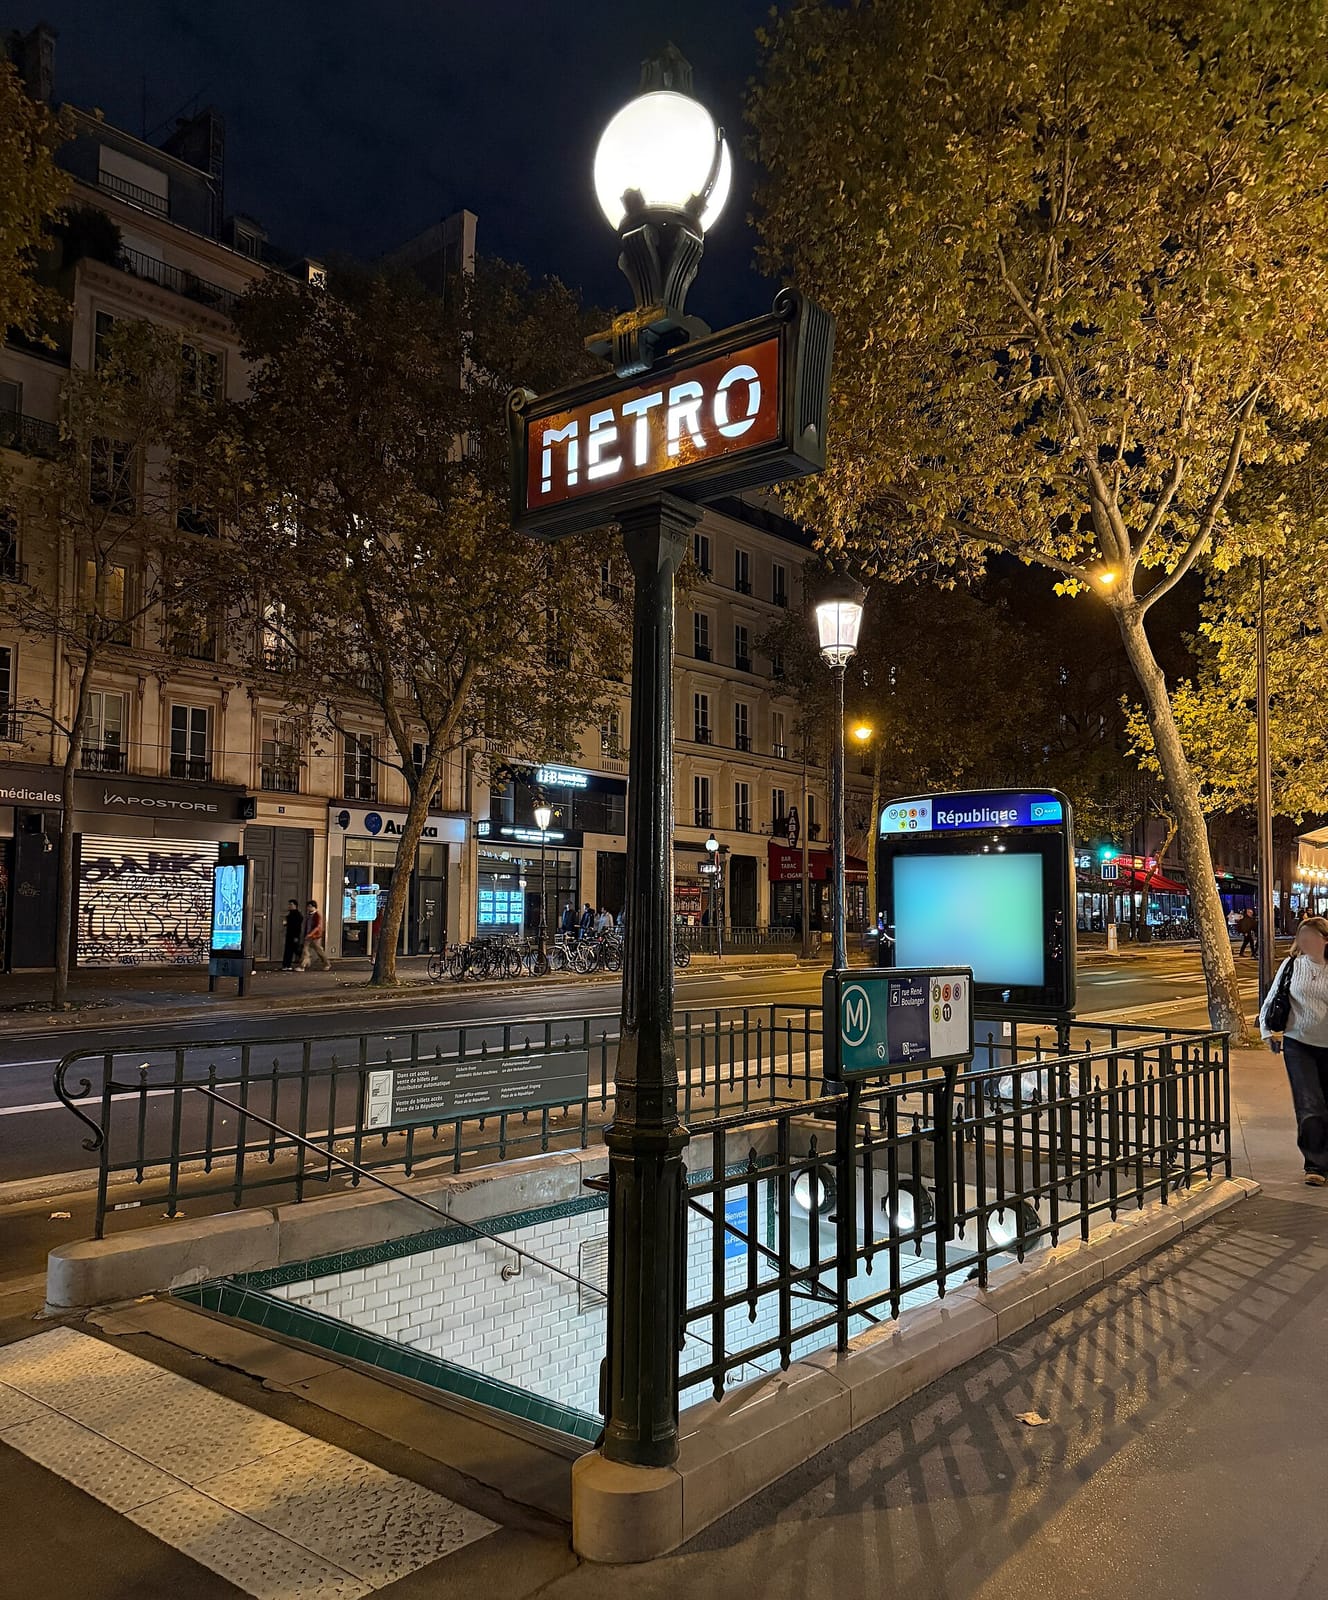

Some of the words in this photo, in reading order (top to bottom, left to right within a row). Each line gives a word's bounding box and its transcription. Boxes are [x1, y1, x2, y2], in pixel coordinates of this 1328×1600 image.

[541, 364, 762, 493] METRO
[0, 787, 62, 802] médicales
[103, 787, 218, 812] VAPOSTORE
[937, 809, 1017, 826] République
[384, 820, 437, 837] Auka
[788, 808, 797, 846] TABAC
[217, 910, 241, 926] Chloé
[892, 991, 898, 1004] 6
[910, 987, 923, 995] René
[934, 987, 939, 999] 3
[944, 987, 949, 998] 5
[954, 986, 959, 997] 8
[846, 998, 864, 1033] M
[934, 1008, 939, 1019] 9
[943, 1005, 951, 1018] 11
